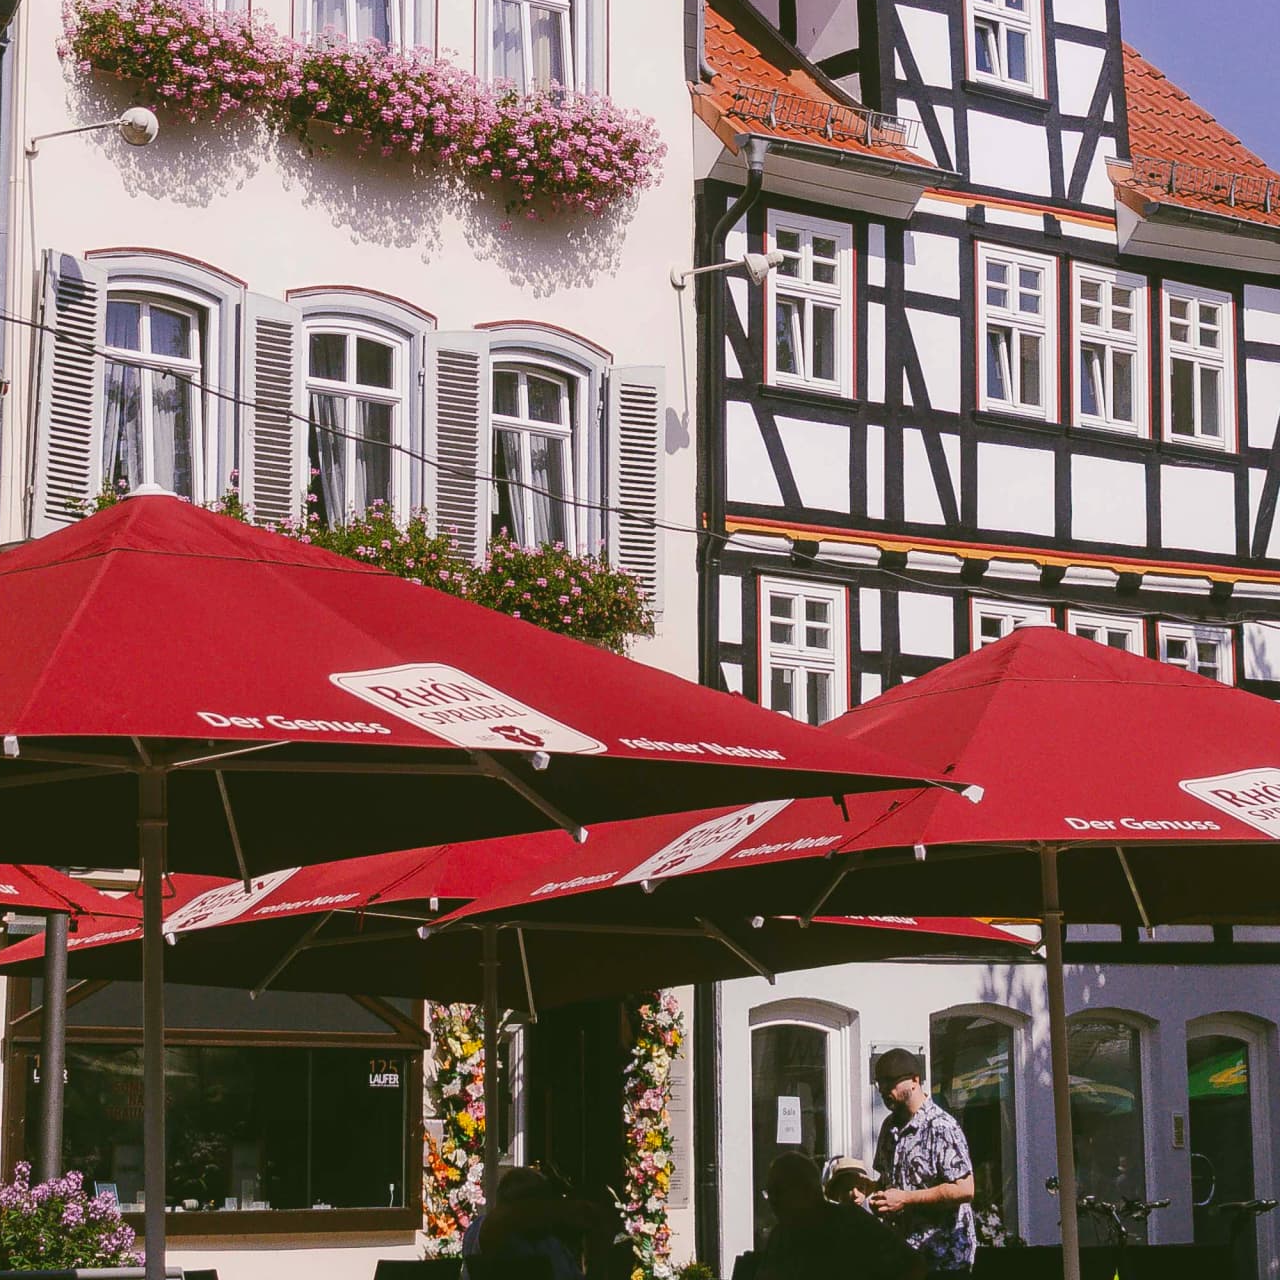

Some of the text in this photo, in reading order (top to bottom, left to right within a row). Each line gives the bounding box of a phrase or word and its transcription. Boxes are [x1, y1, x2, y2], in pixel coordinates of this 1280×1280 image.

[367, 677, 495, 709] RHÖN
[418, 704, 527, 725] SPRUDEL
[196, 711, 787, 760] Der Genuss reiner Natur
[1064, 816, 1116, 832] Der
[1119, 817, 1221, 832] Genuss
